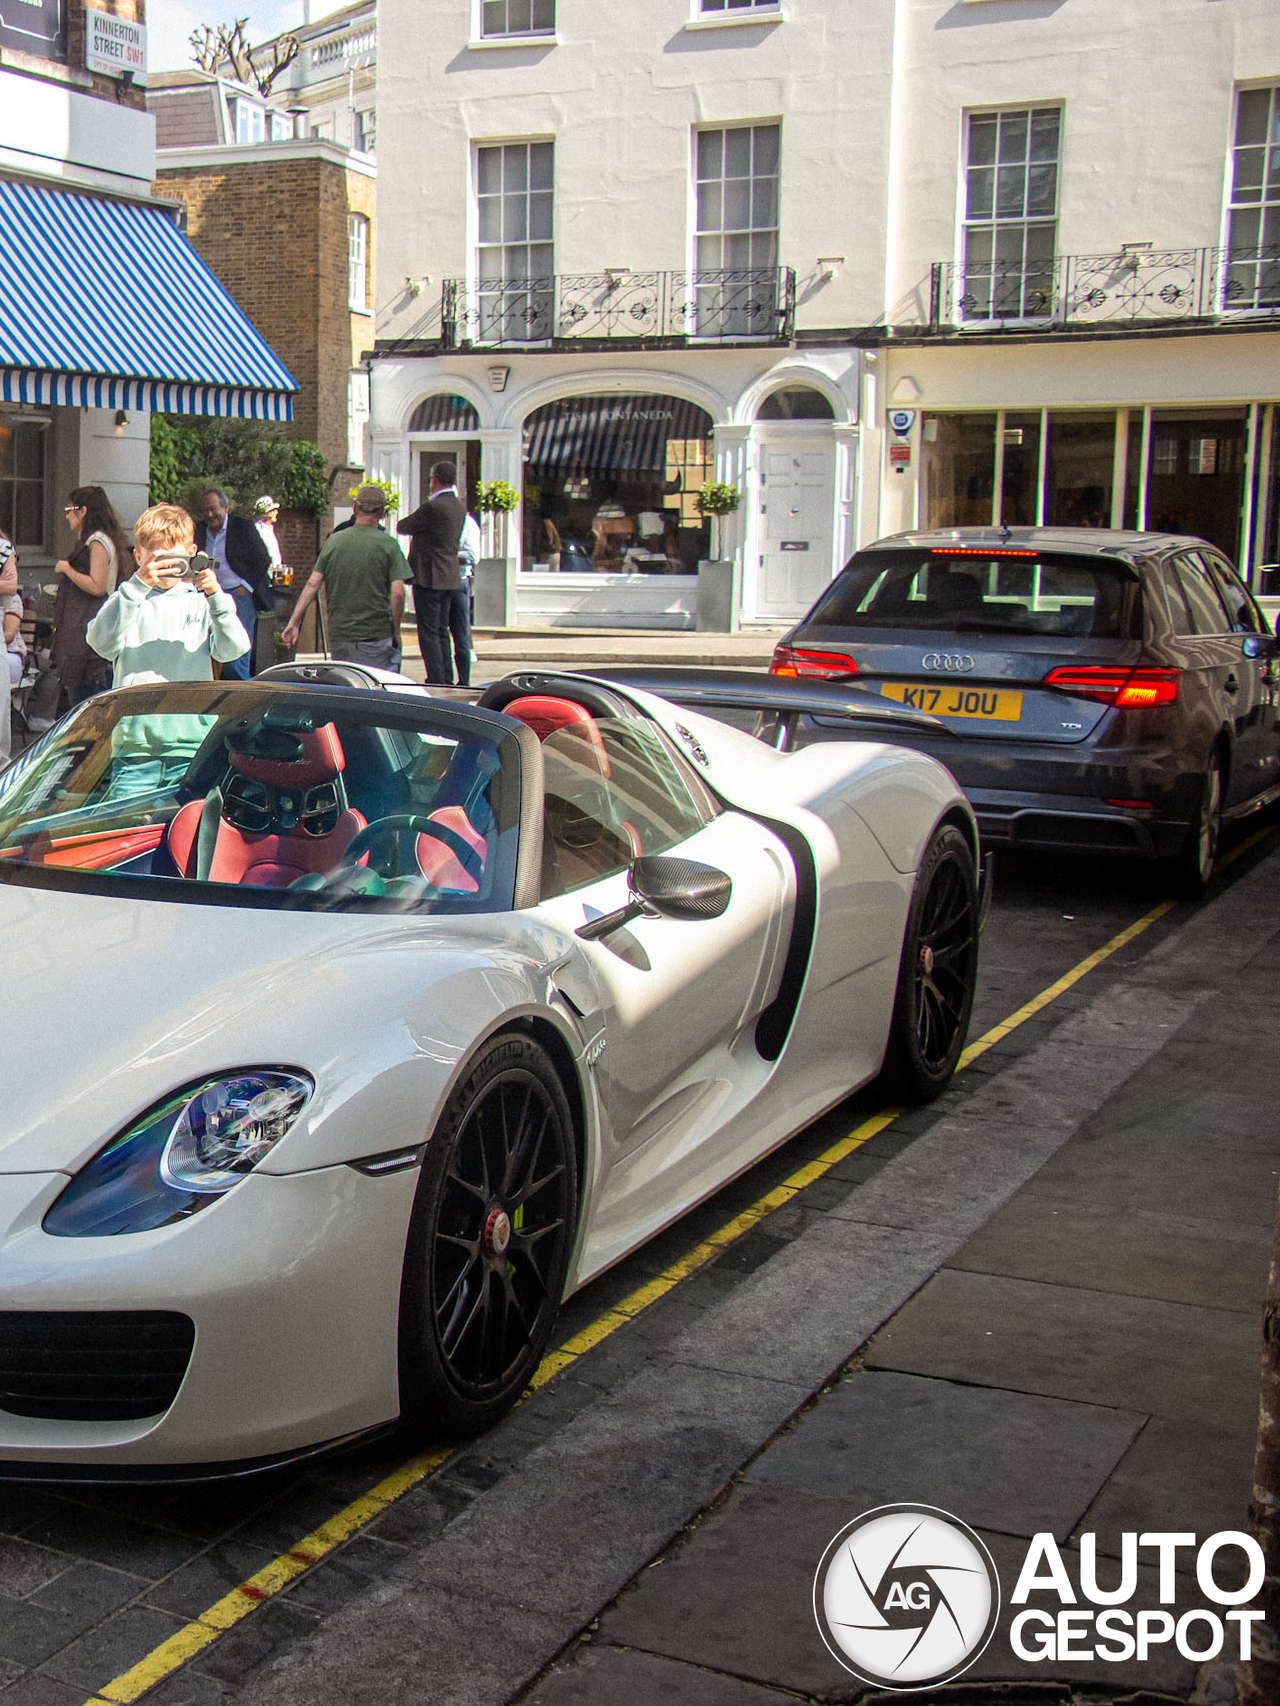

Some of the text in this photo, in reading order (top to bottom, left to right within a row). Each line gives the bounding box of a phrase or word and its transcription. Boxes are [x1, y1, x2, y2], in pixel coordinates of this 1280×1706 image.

[94, 16, 140, 45] KINNERTON
[94, 34, 144, 65] STREET SW1
[903, 687, 998, 715] K17 JOU
